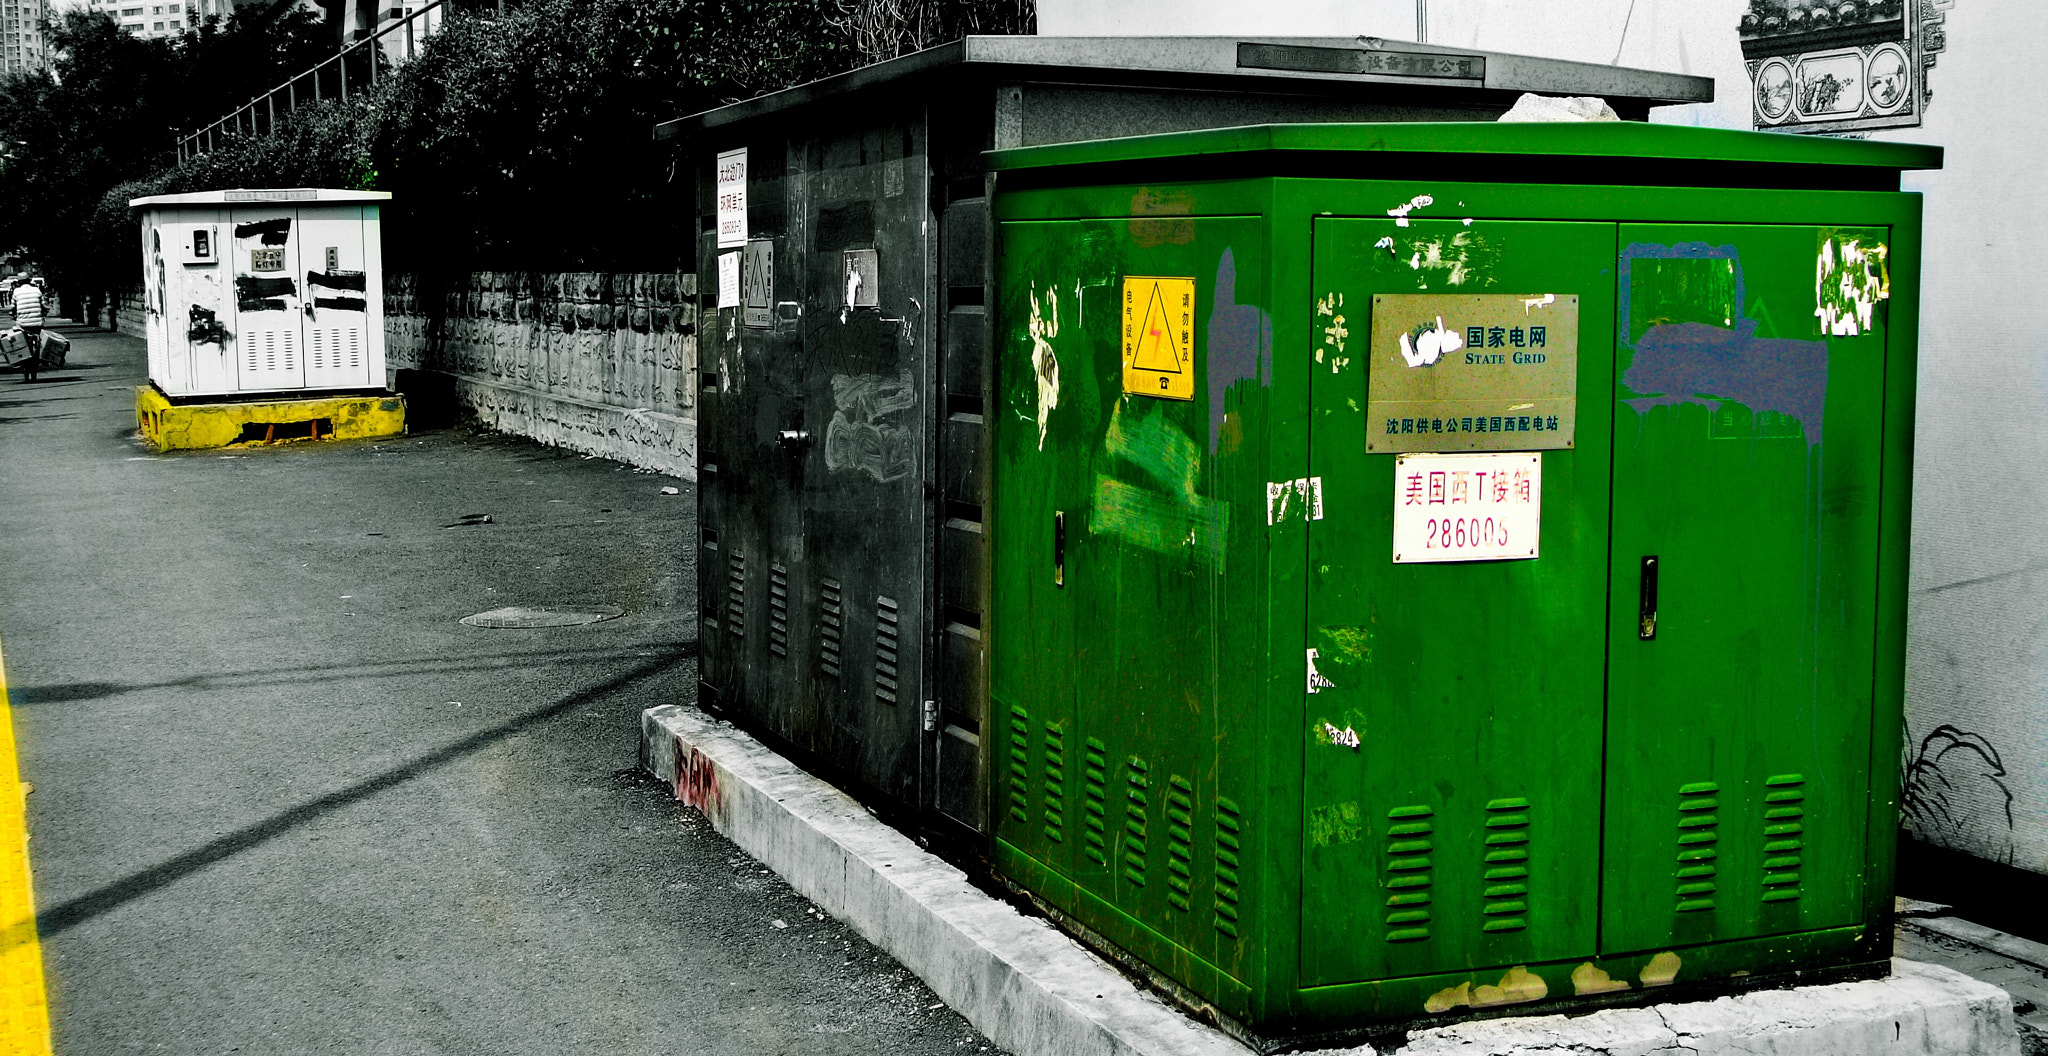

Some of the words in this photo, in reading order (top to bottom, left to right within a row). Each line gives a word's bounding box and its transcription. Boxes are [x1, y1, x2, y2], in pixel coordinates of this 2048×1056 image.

[1466, 326, 1546, 348] 国家电网
[1386, 416, 1558, 435] 沈阳供电公司美国西配电站
[1406, 467, 1530, 506] 美国西T接箱
[1427, 516, 1508, 549] 286005
